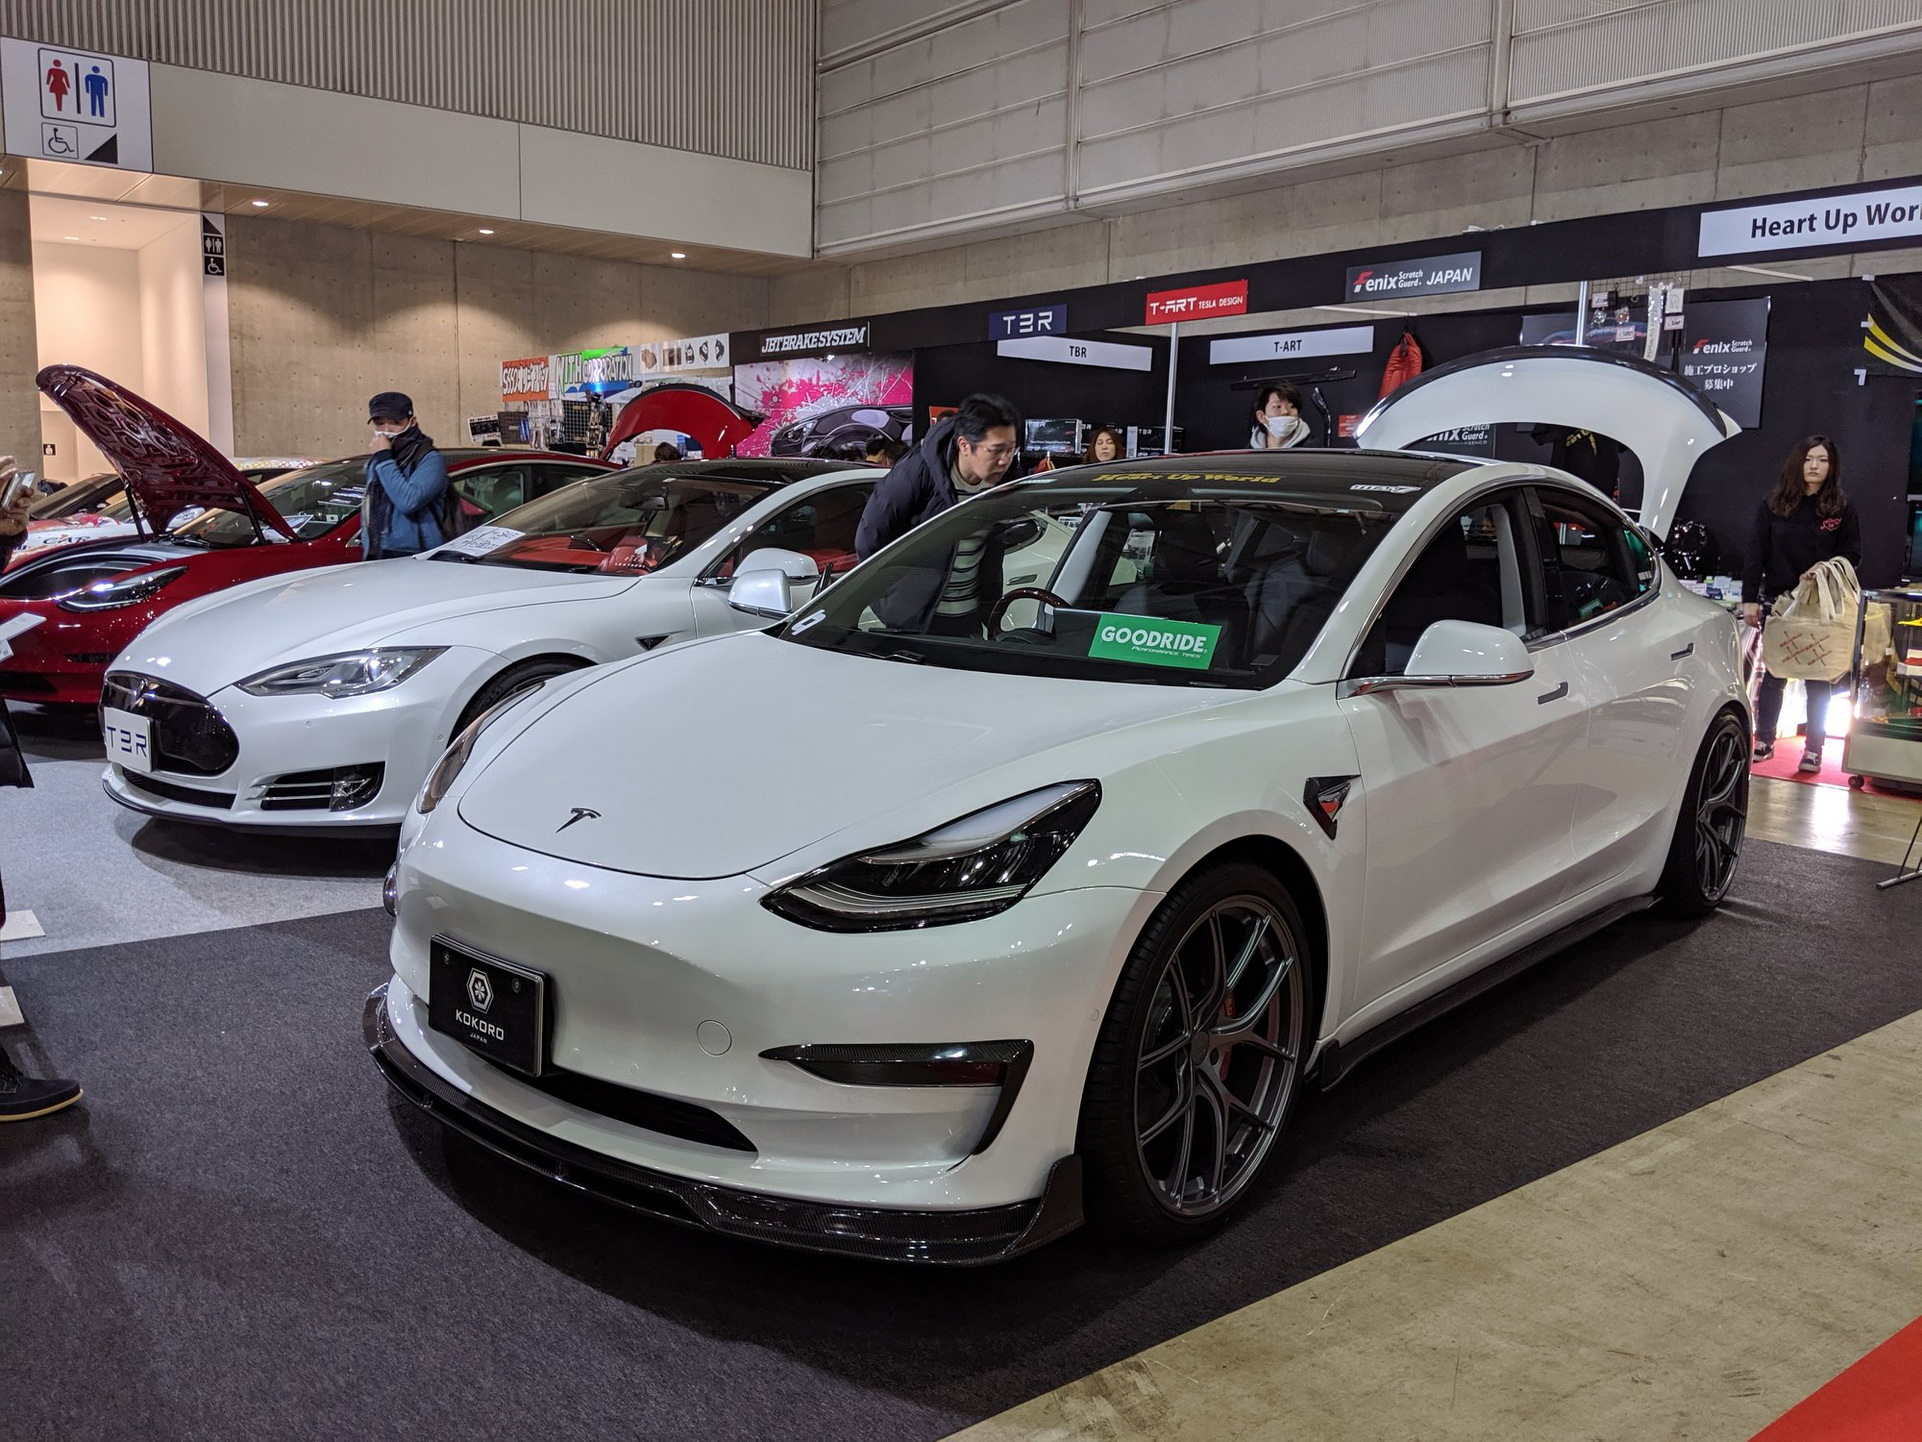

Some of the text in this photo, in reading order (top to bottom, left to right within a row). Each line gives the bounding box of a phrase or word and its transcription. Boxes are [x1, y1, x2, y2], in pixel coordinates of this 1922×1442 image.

[1751, 213, 1817, 238] Heart
[1824, 208, 1858, 234] Up
[1353, 267, 1473, 292] Fenix Scratch JAPAN
[1149, 296, 1243, 315] T-ART TESLA DESIGN
[1002, 311, 1053, 335] TBR
[761, 327, 866, 353] JBT BRAKE SYSTEM
[1273, 339, 1303, 353] T-ART
[1069, 345, 1087, 358] TBR
[1167, 472, 1201, 481] Up
[1204, 473, 1282, 484] World
[455, 1009, 504, 1041] KOKORO
[469, 1032, 488, 1044] JAPAN
